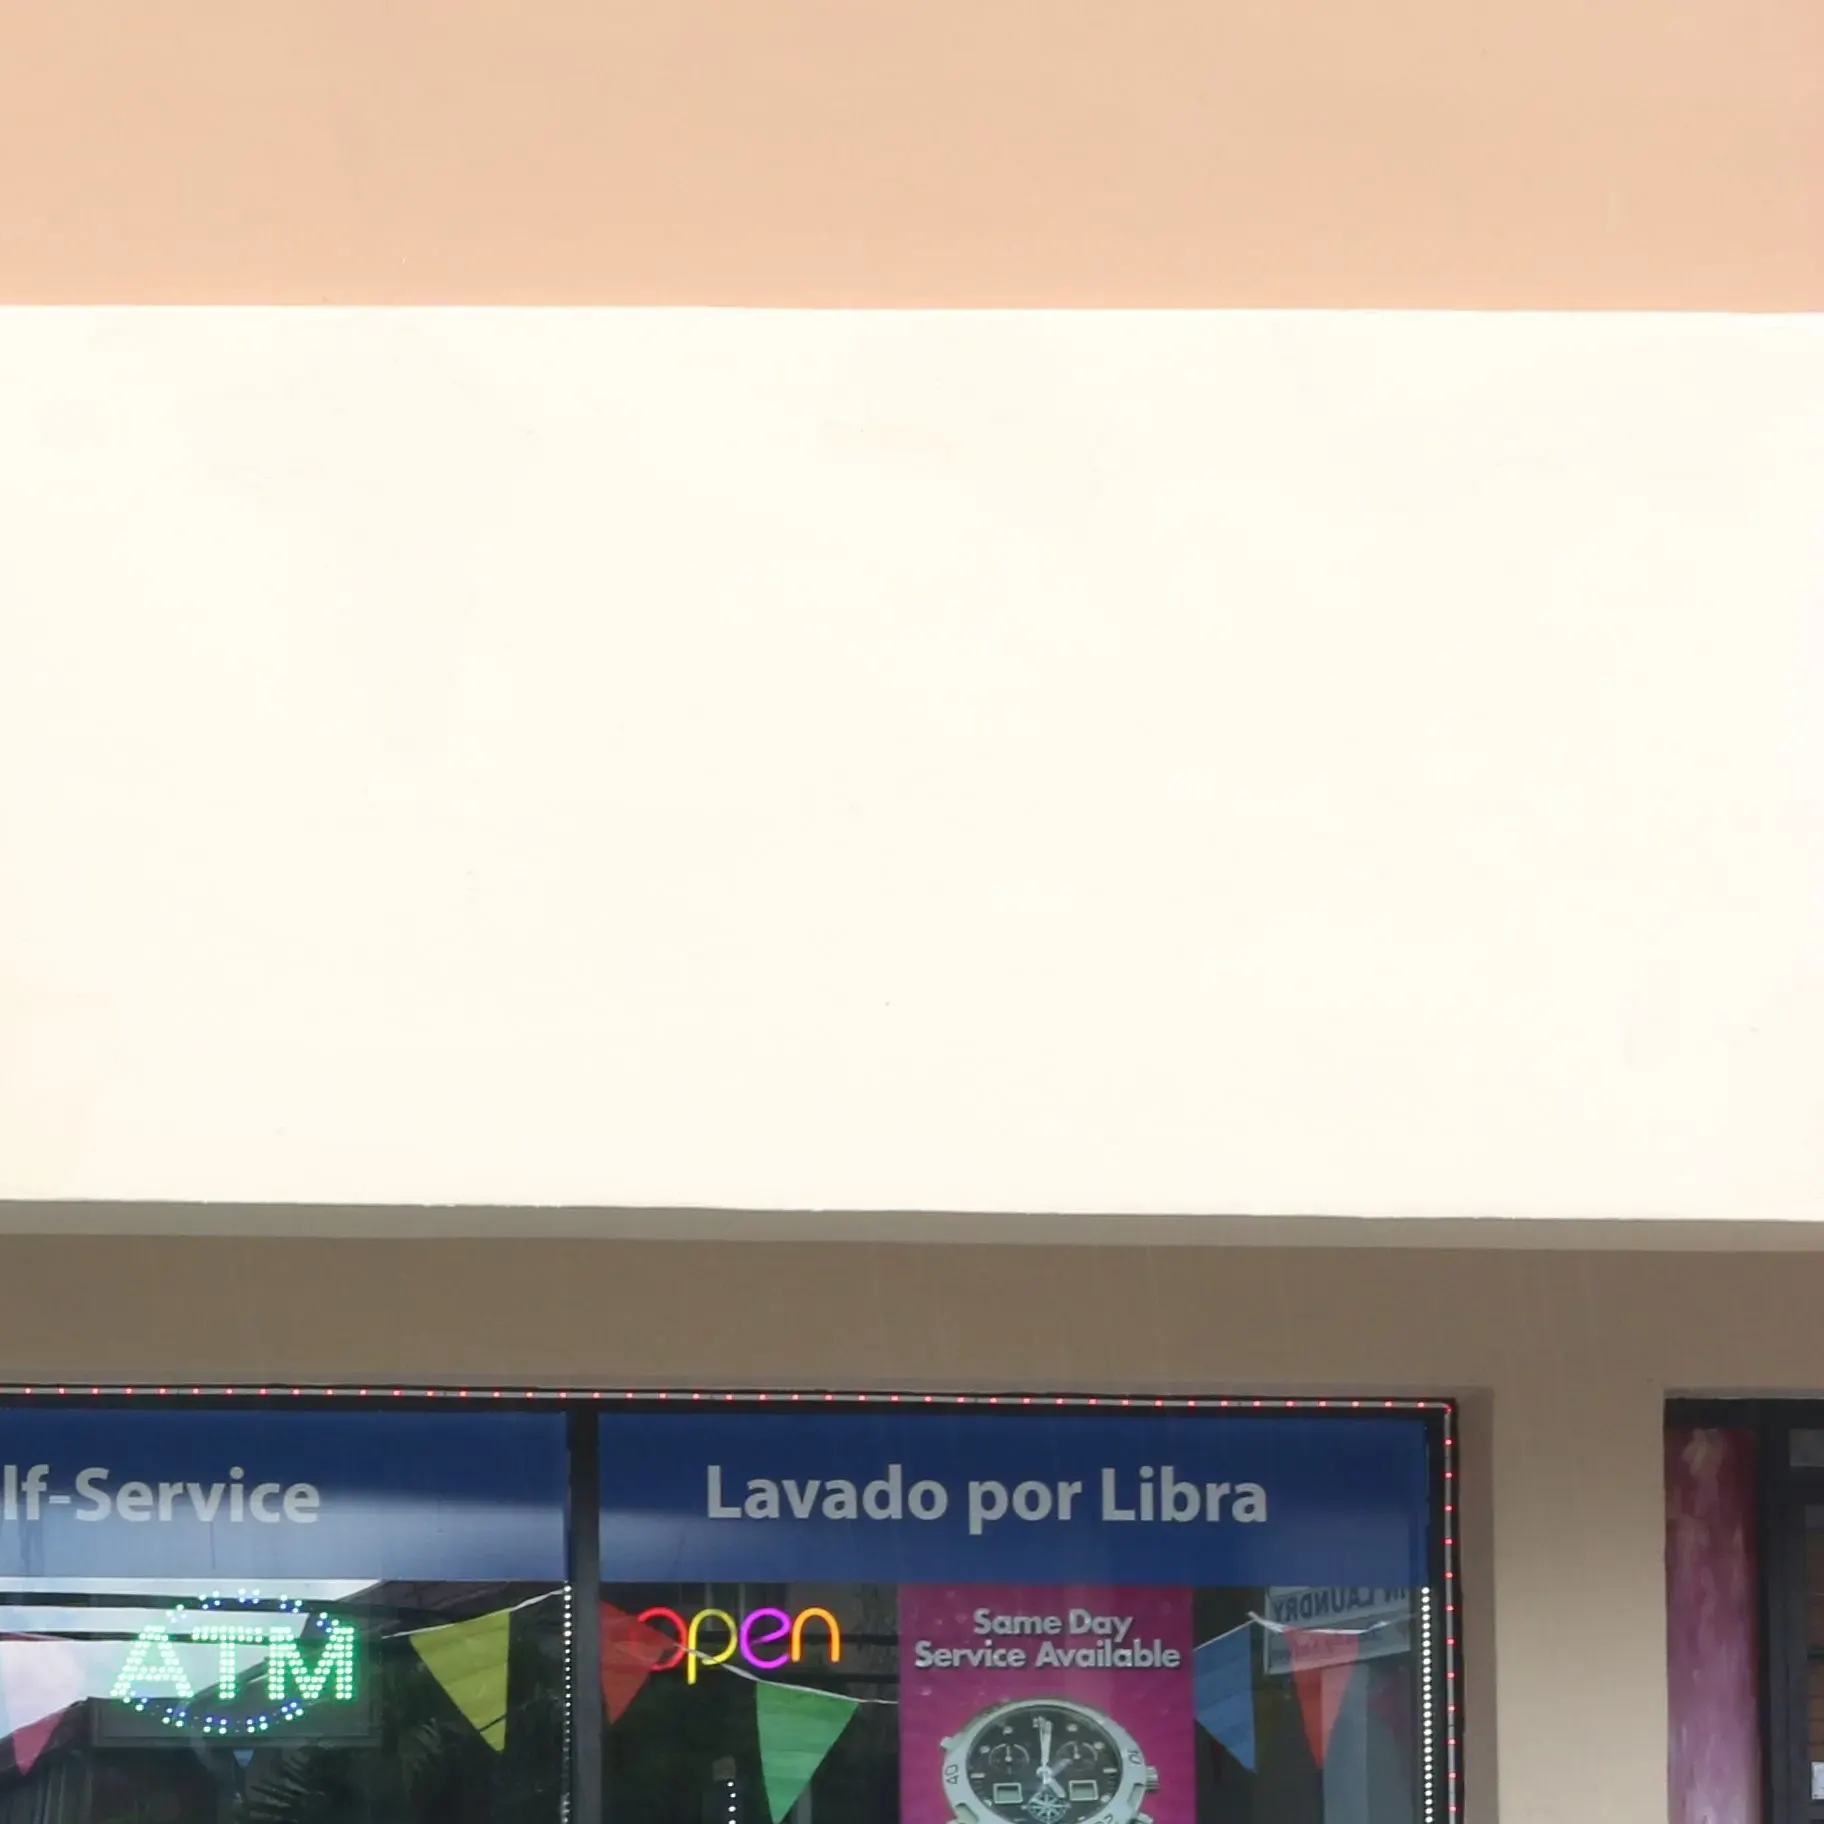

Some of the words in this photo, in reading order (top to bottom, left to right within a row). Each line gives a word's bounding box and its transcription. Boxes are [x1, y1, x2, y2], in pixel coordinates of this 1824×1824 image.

[706, 1463, 947, 1521] Lavado
[968, 1480, 1081, 1534] por
[1101, 1466, 1268, 1523] Libra
[628, 1606, 841, 1685] open
[914, 1640, 1029, 1670] Service
[1036, 1640, 1181, 1671] Available
[974, 1608, 1063, 1637] Same
[1071, 1609, 1132, 1641] Day
[110, 1627, 356, 1701] ATM
